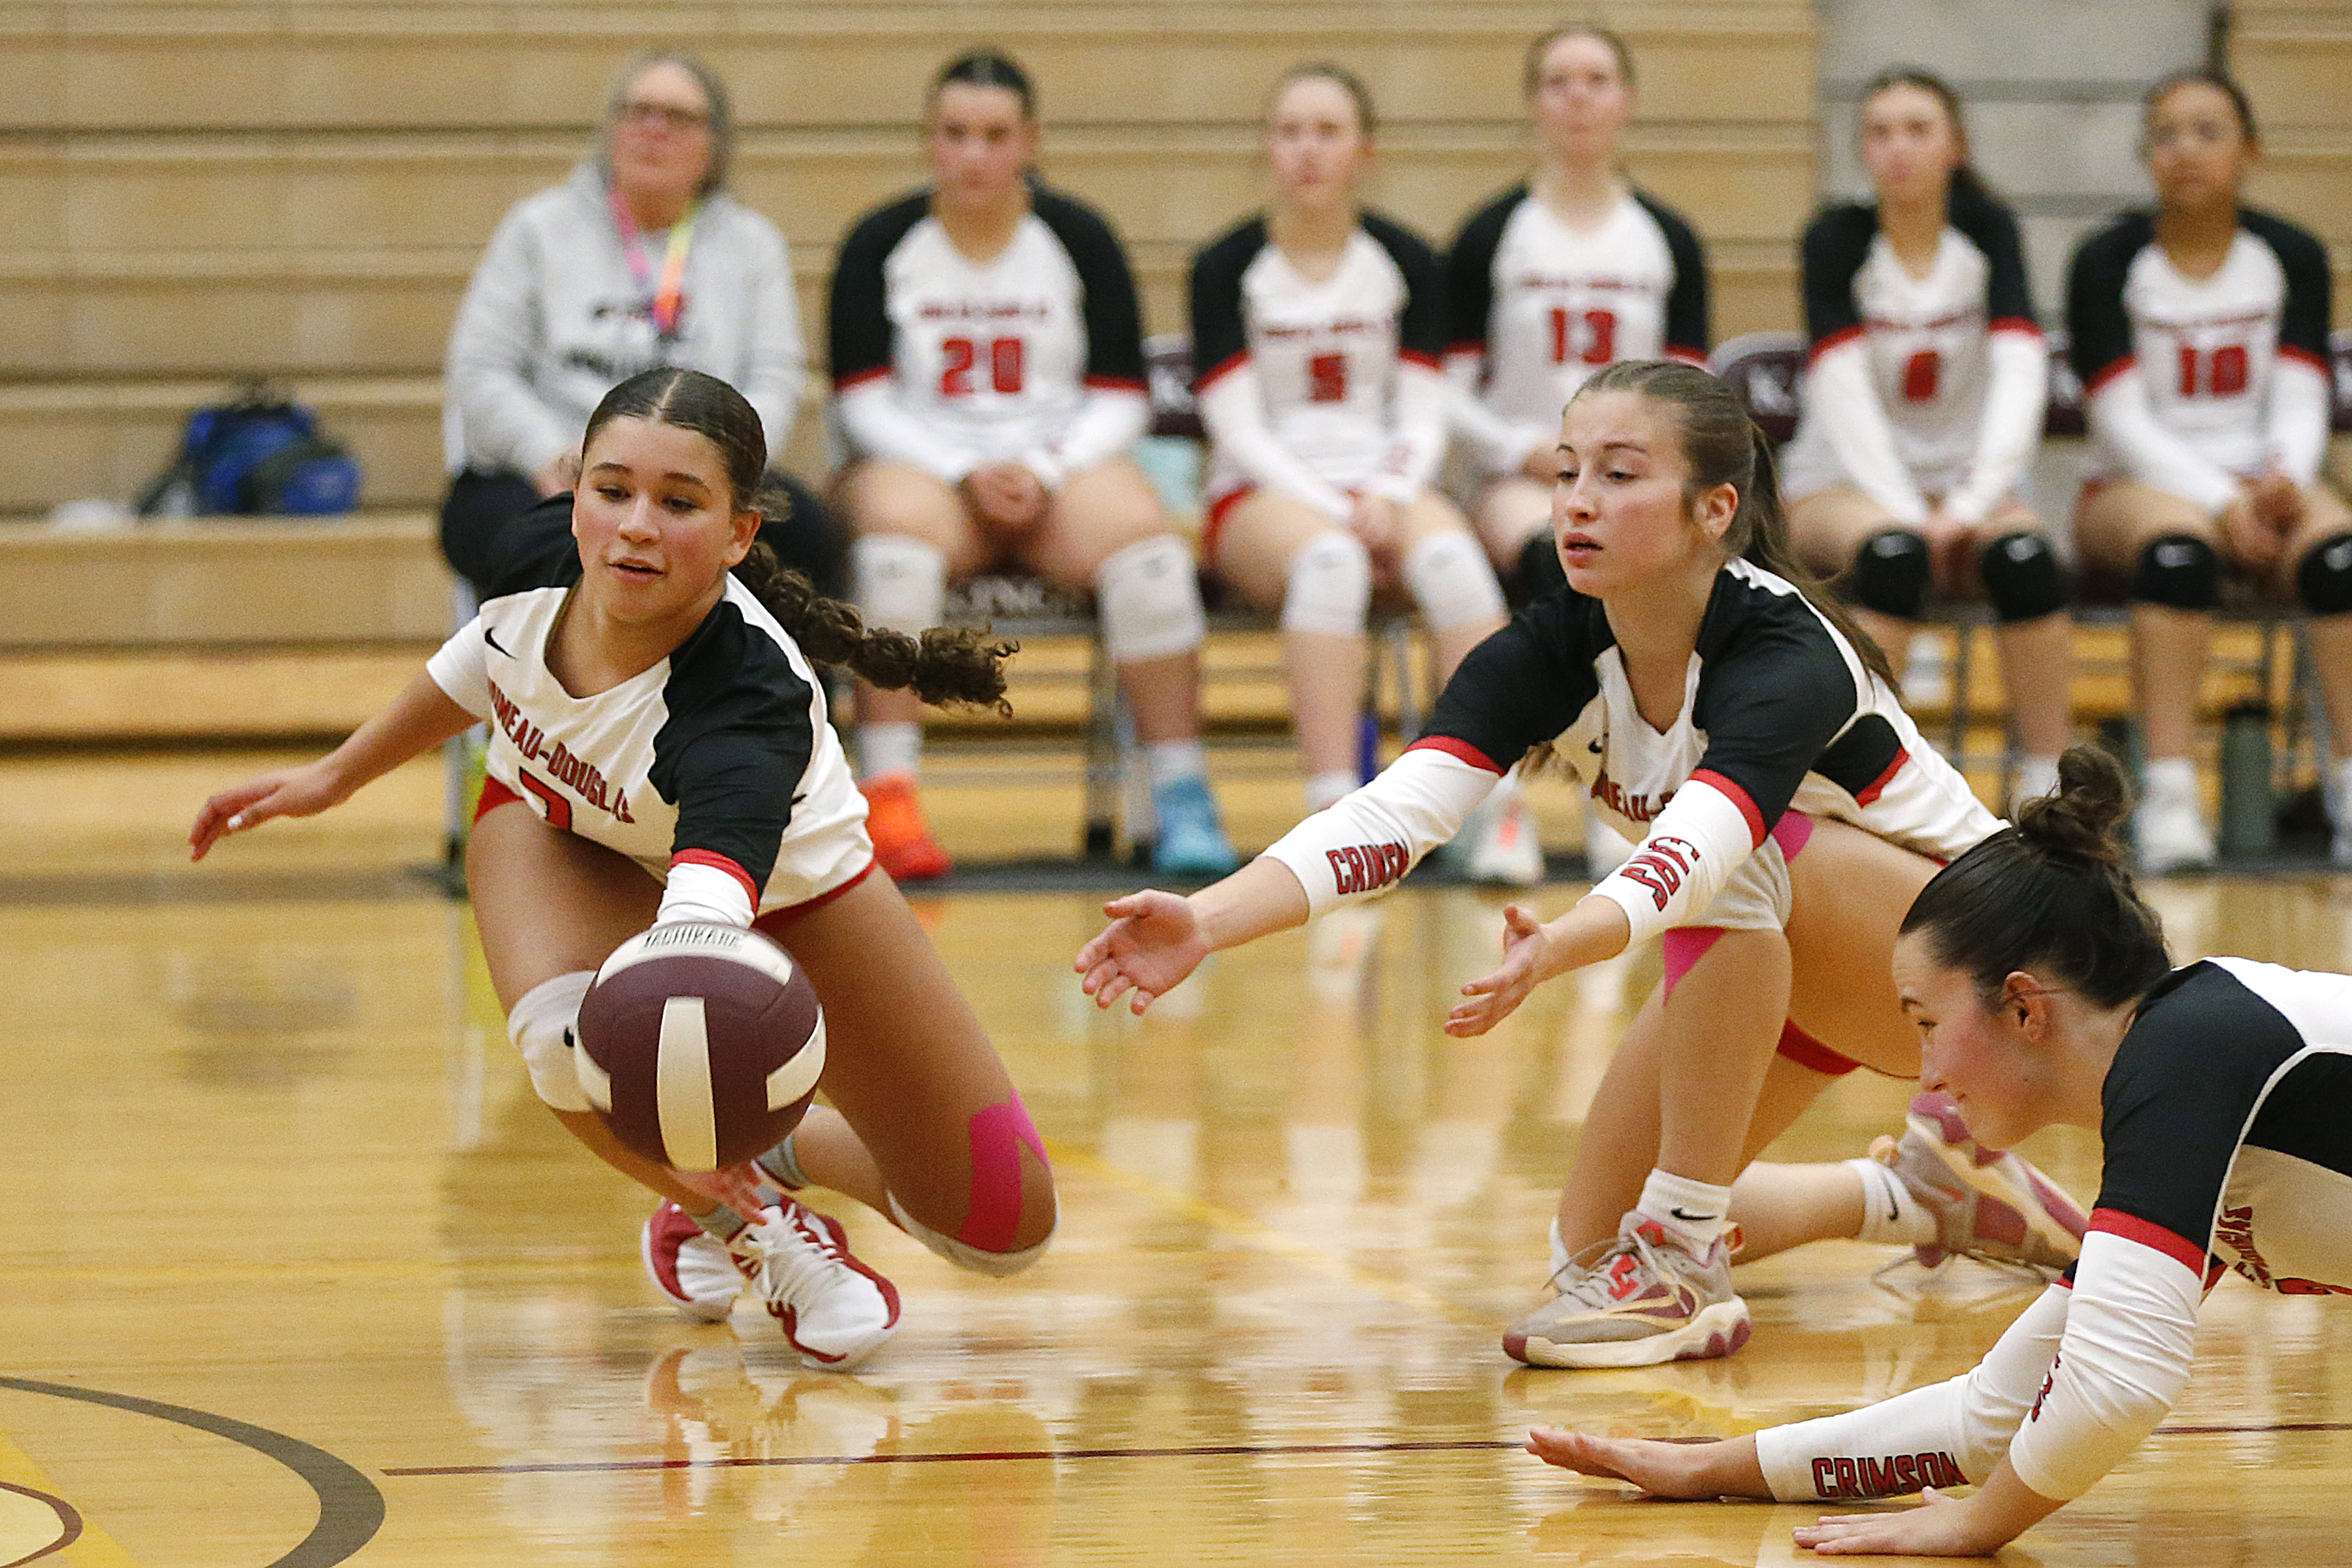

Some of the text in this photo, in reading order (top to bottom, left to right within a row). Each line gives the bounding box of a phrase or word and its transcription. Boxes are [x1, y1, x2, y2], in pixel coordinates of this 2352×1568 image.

[1550, 307, 1618, 367] 13
[939, 336, 1024, 398] 20
[2178, 344, 2249, 397] 10
[1811, 1451, 1971, 1497] CRIMSON
